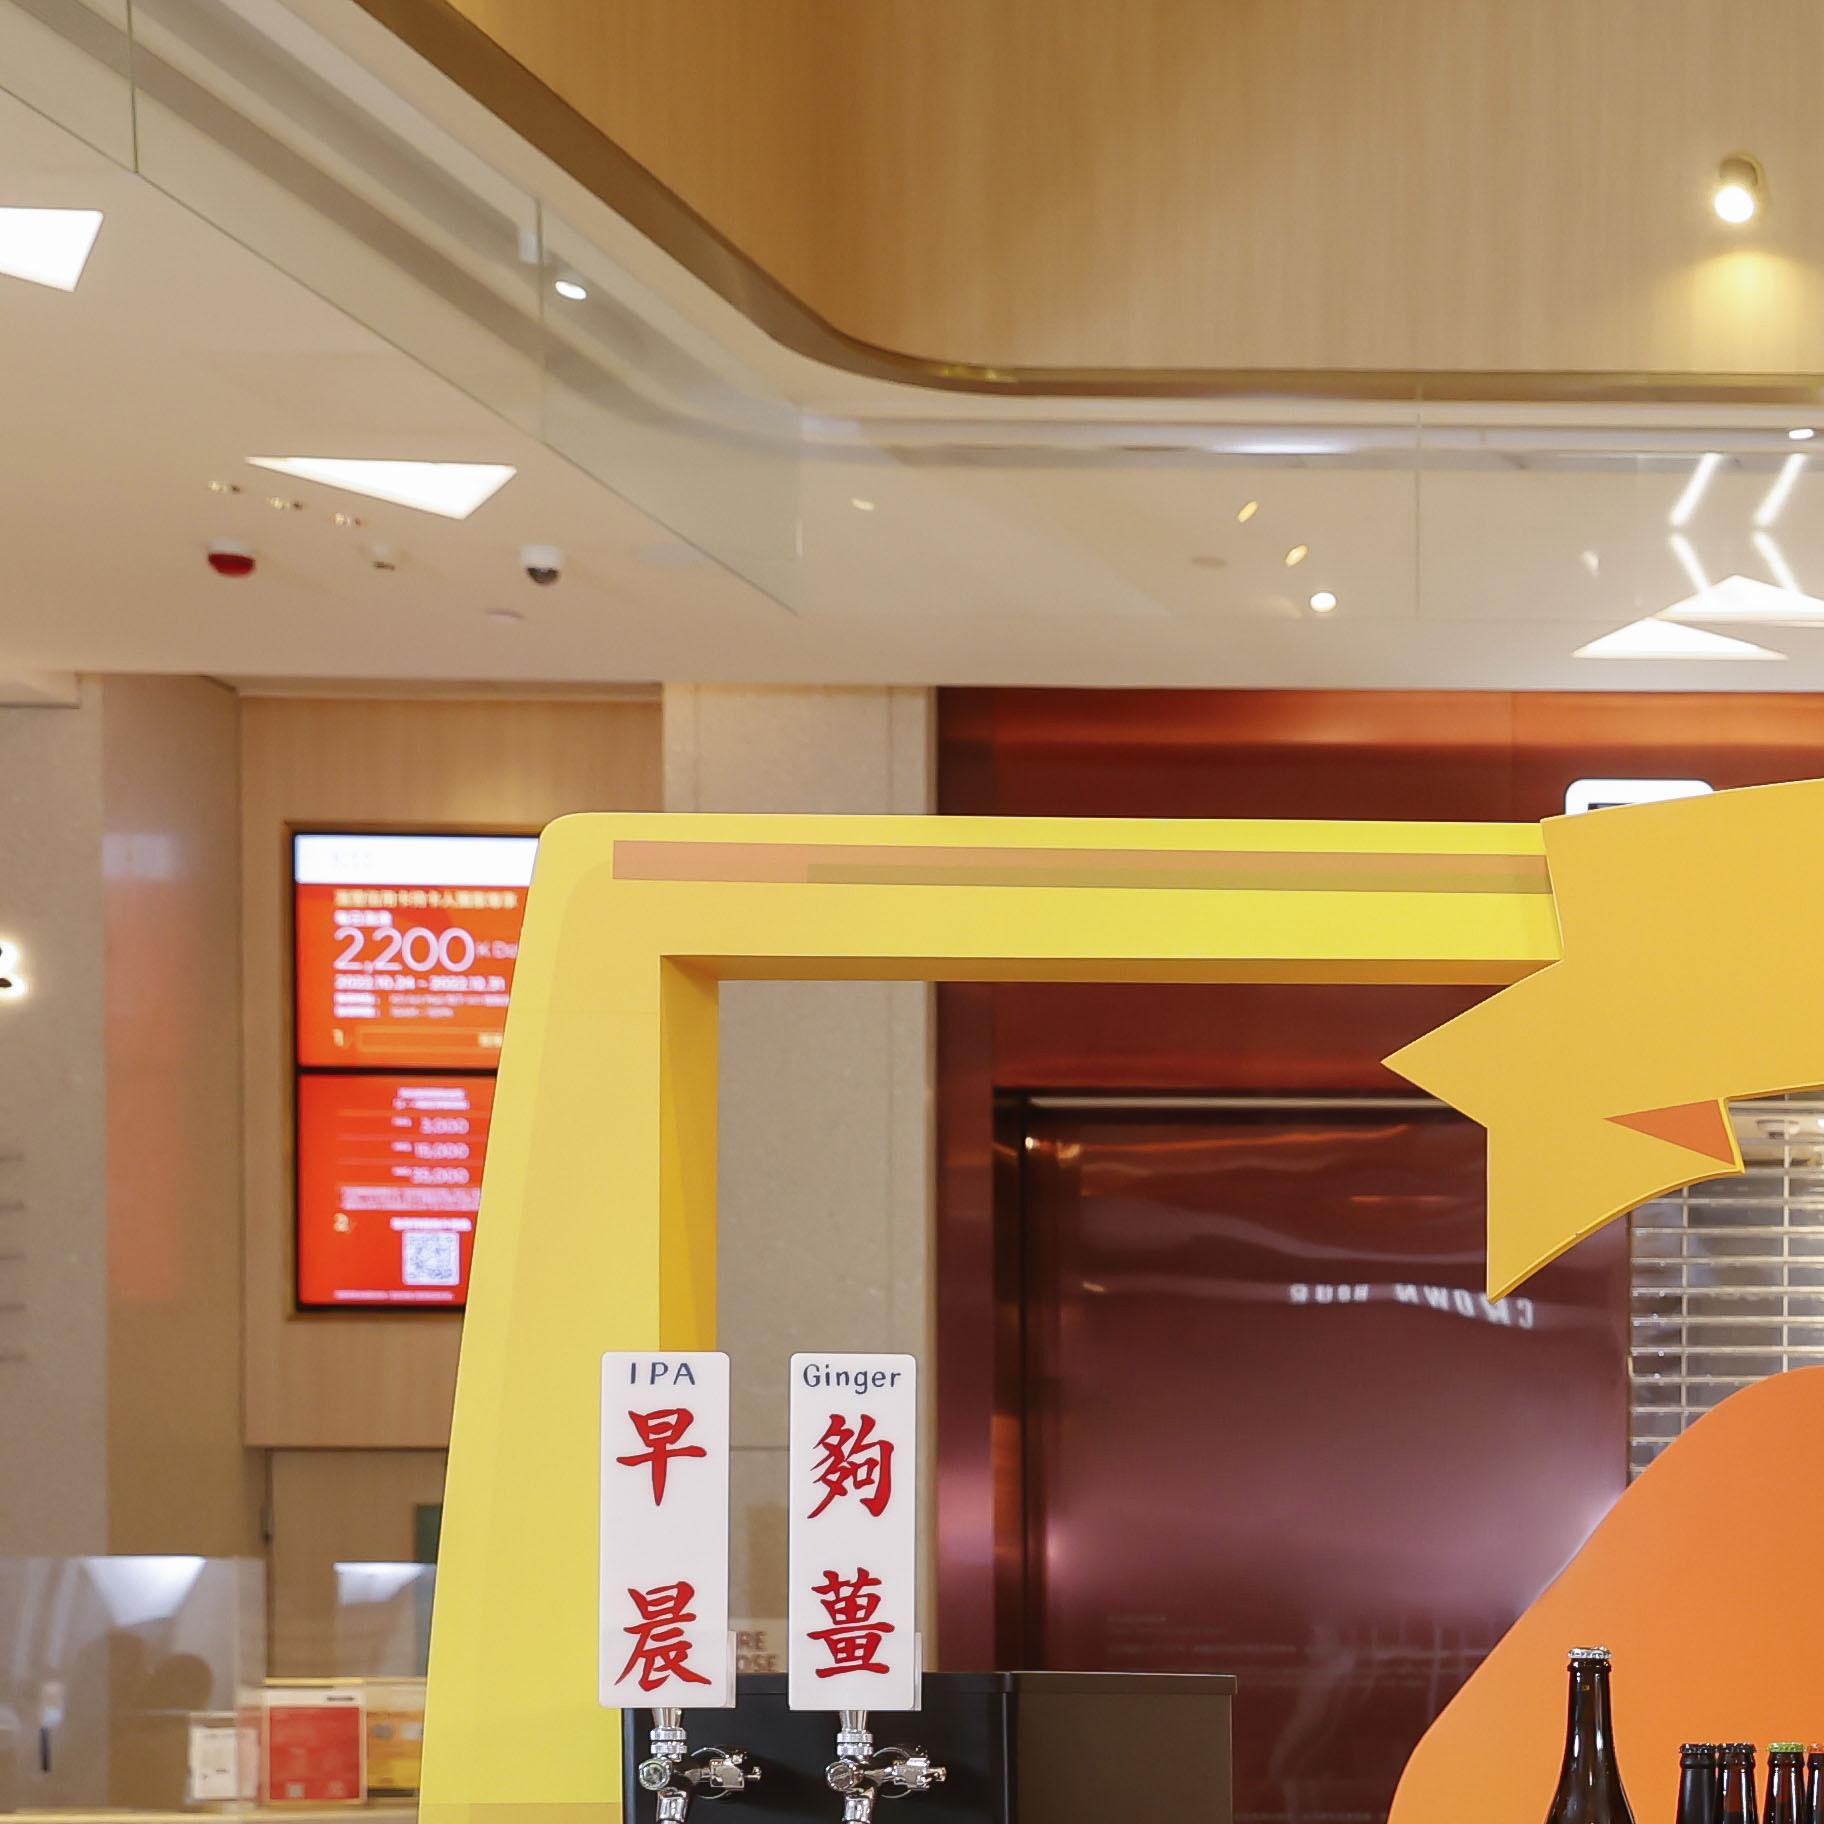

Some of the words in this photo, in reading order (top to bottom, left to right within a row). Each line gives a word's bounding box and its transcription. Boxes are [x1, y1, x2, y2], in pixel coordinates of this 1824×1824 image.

[333, 927, 475, 972] 2,200
[629, 1362, 696, 1386] IPA
[803, 1364, 902, 1395] Ginger
[614, 1408, 712, 1692] 早晨
